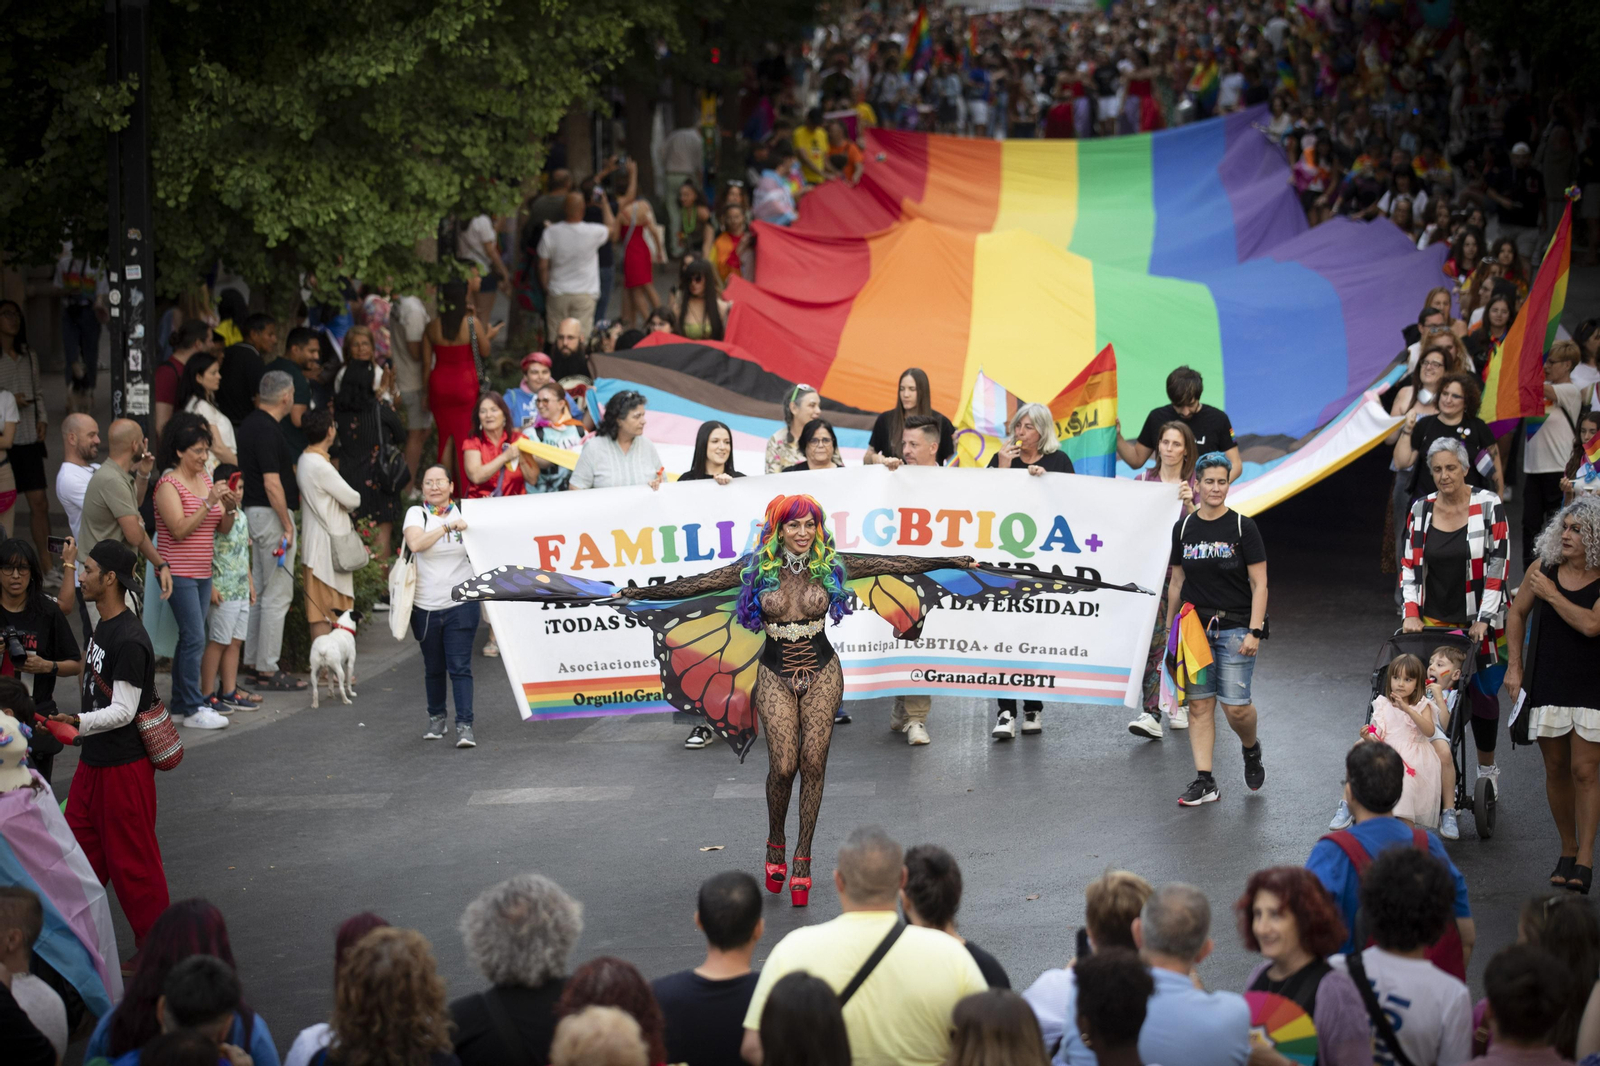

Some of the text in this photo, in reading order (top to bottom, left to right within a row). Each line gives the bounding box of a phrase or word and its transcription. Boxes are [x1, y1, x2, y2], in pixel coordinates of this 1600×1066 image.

[831, 507, 1104, 559] LGBTIQA+
[545, 615, 620, 635] ¡TODAS
[833, 638, 1088, 657] Municipal LGBTIQA+ de Granada
[558, 659, 657, 674] Asociaciones
[910, 669, 1056, 688] @GranadaLGBTI
